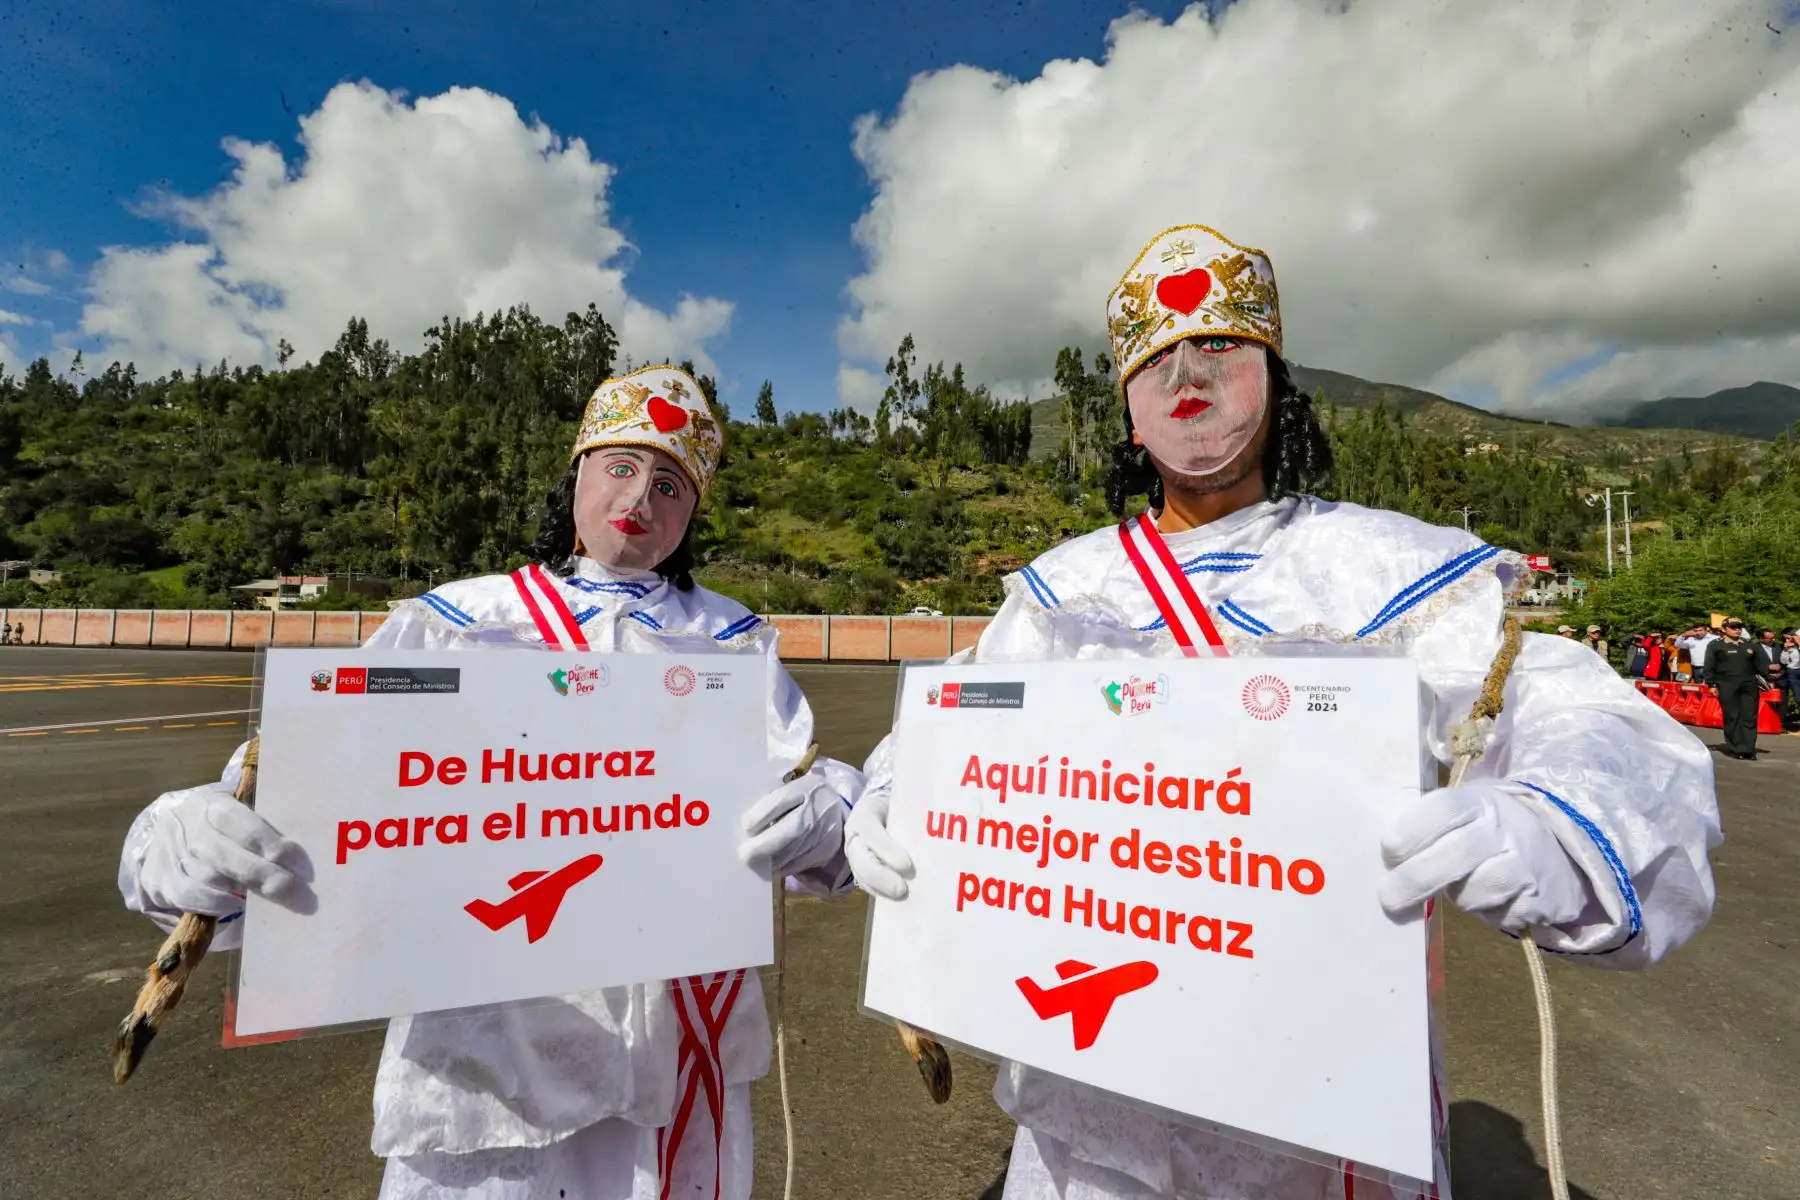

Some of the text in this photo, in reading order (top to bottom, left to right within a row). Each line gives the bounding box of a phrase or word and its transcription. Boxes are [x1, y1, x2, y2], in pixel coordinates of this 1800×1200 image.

[339, 675, 363, 685] PERÚ
[370, 676, 411, 684] Presidencia
[568, 669, 599, 684] PUHE
[382, 683, 411, 692] Consejo
[705, 682, 724, 690] 2024
[1122, 681, 1156, 701] PUHE
[1294, 685, 1351, 693] BICENTENARIO
[1306, 703, 1338, 712] 2024
[399, 747, 656, 787] De Huaraz
[960, 754, 1252, 817] Aquí iniciará
[335, 793, 711, 866] para el mundo
[926, 811, 1327, 896] un mejor destino
[956, 871, 1255, 960] para Huaraz
